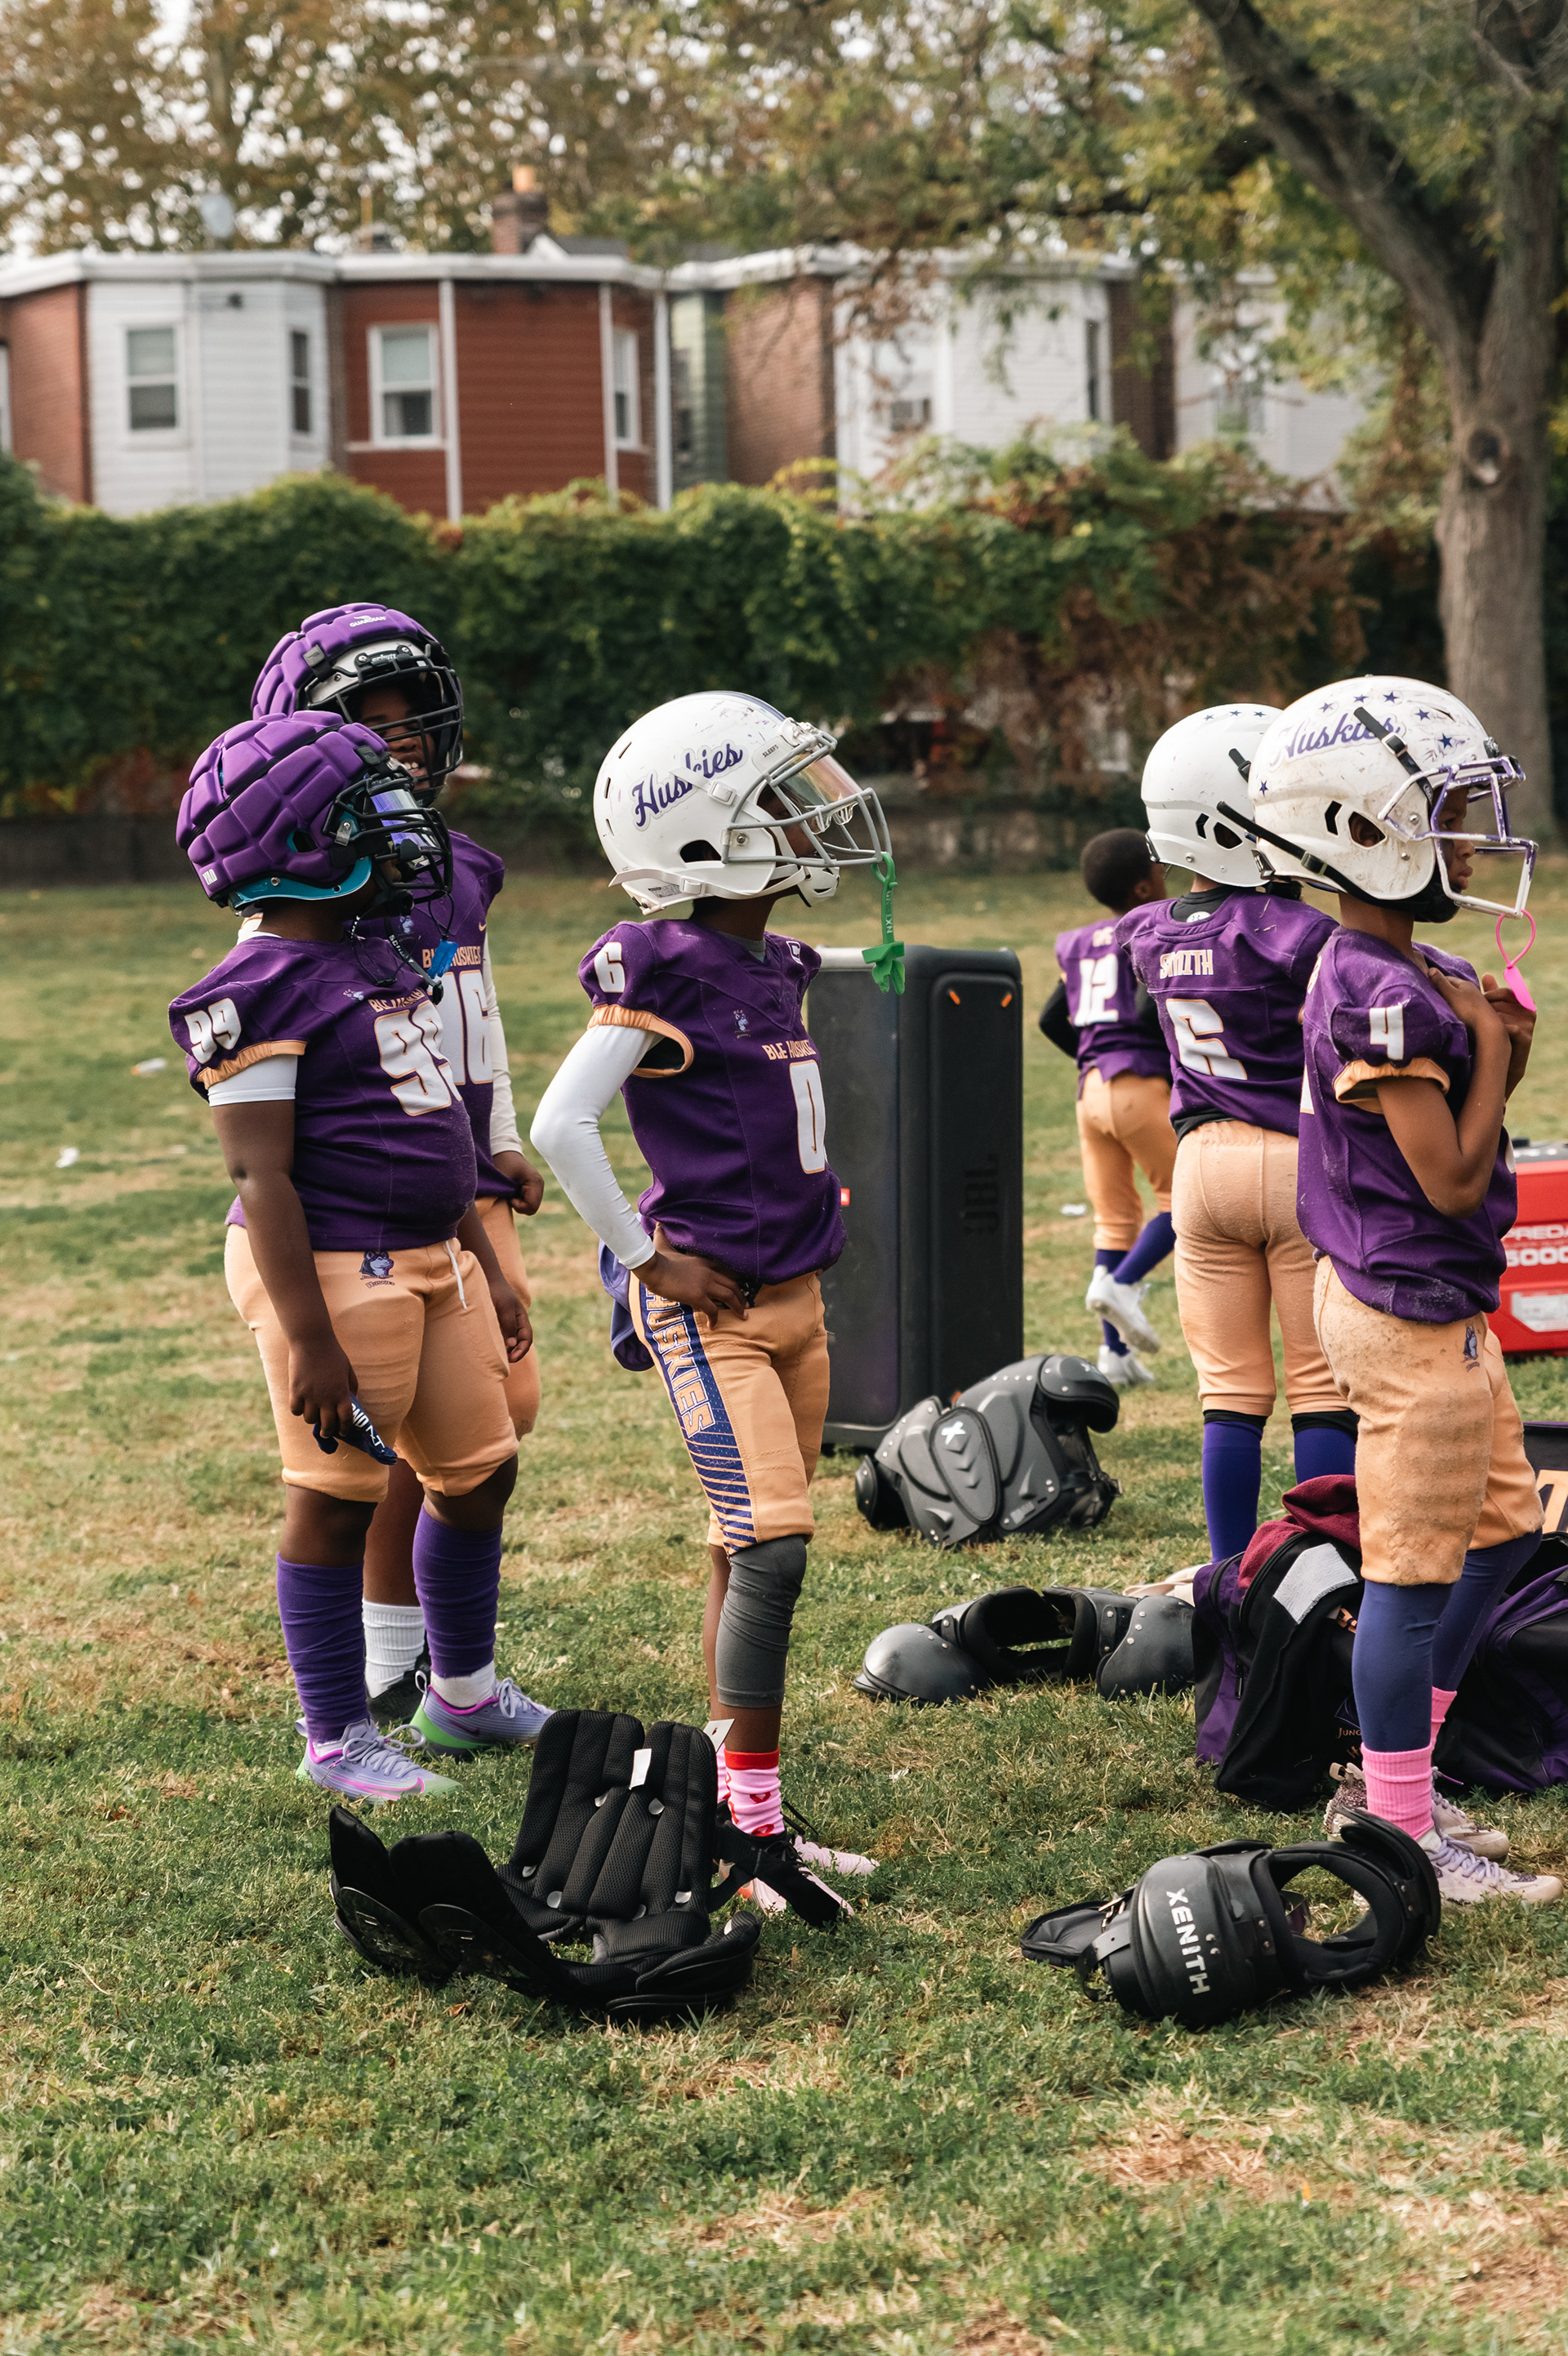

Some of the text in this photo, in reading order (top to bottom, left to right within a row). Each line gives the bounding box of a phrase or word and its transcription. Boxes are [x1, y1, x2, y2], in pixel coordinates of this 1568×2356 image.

[349, 616, 386, 627] GUARDIAN
[762, 744, 779, 758] SLEEFS
[631, 742, 743, 827] Huskies
[594, 942, 626, 993] 6
[1074, 953, 1120, 1027] 12
[1160, 949, 1214, 979] SMITH
[184, 997, 242, 1064] 99
[761, 1043, 788, 1061] BLE
[1165, 998, 1248, 1080] 6
[1369, 1004, 1404, 1060] 4
[1166, 1887, 1211, 1995] XENITH
